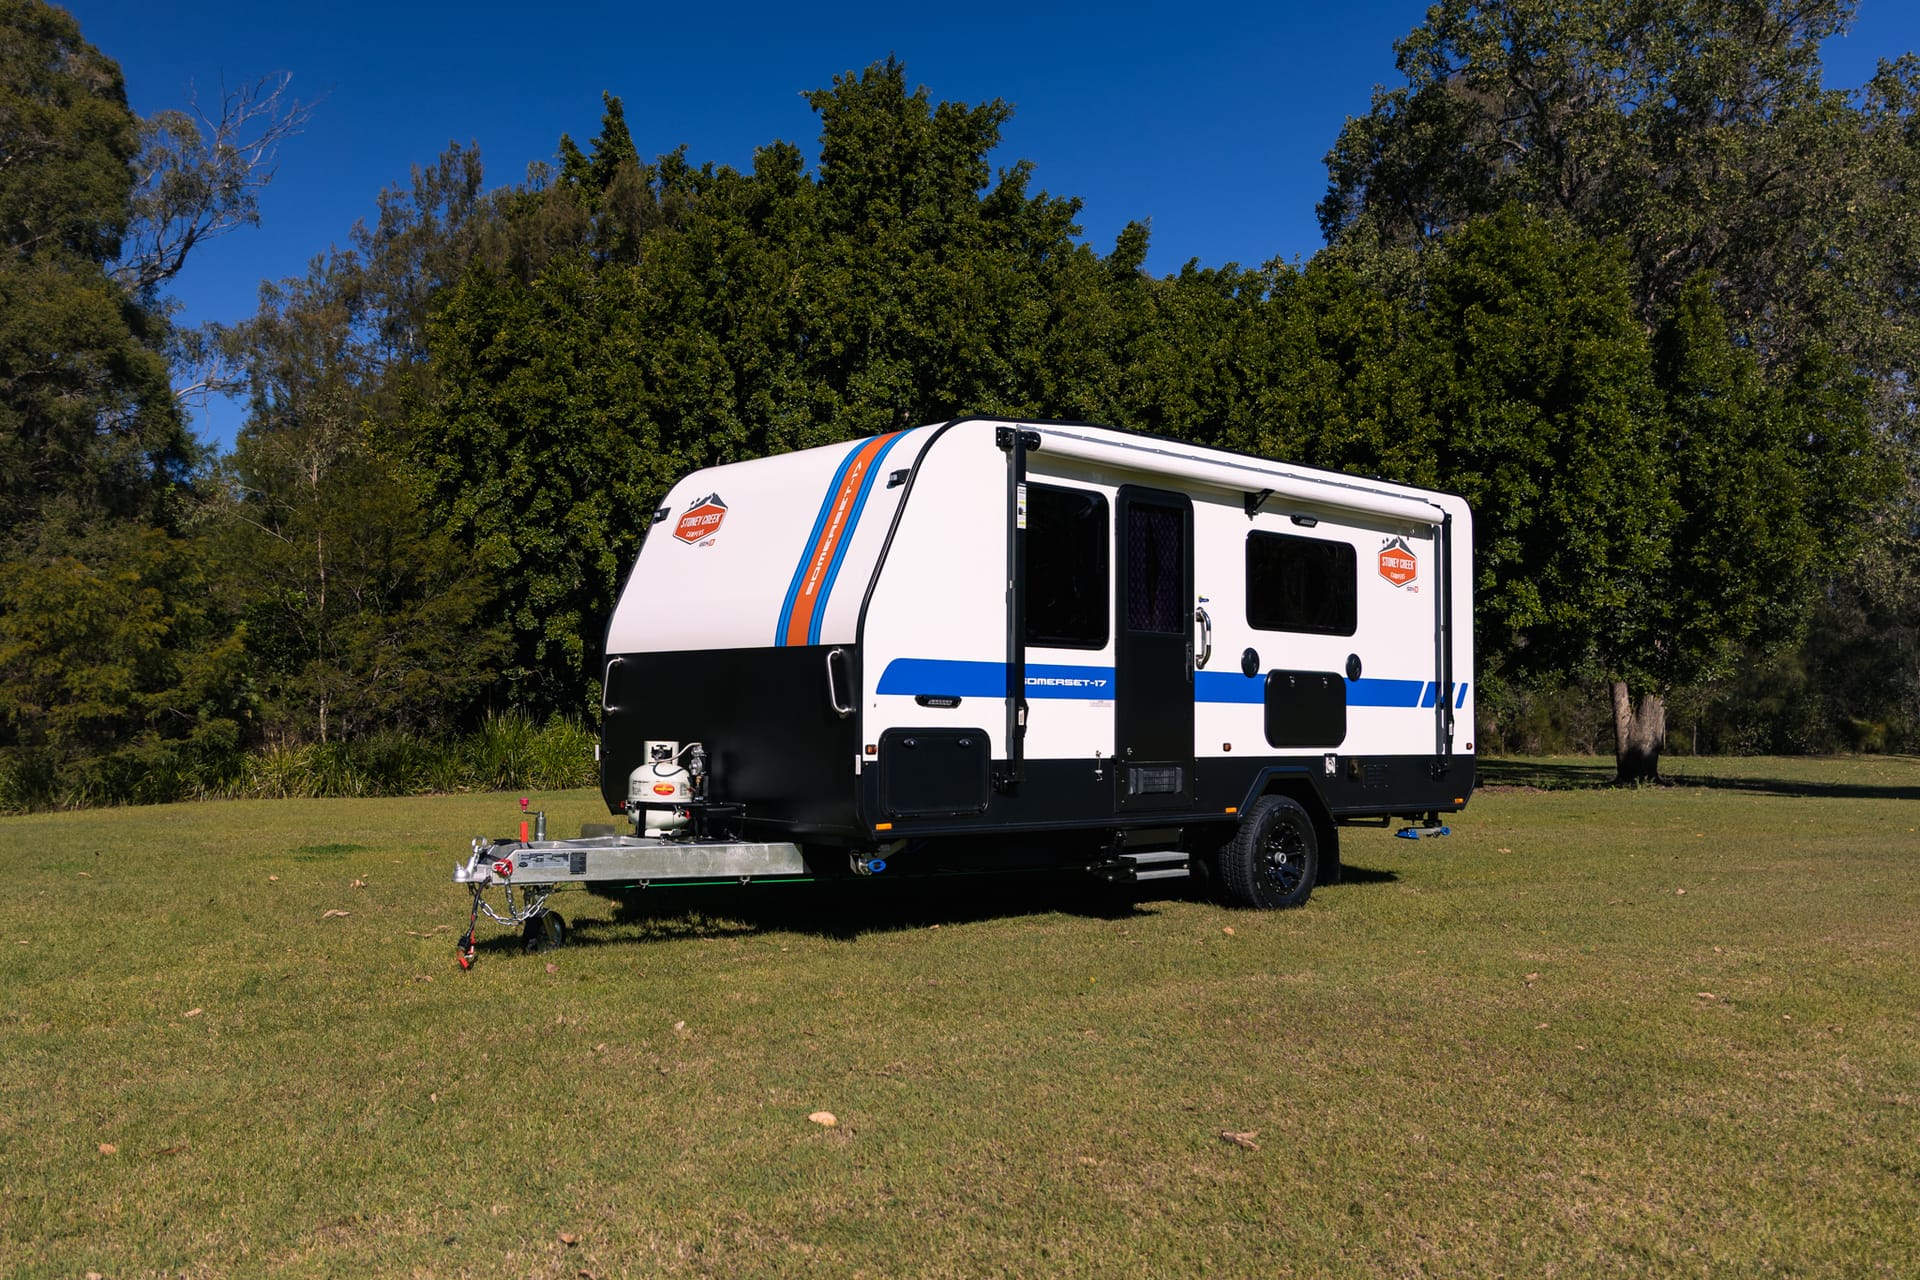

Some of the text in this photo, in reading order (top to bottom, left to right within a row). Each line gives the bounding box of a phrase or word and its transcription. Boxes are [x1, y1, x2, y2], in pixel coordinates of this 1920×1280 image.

[681, 513, 722, 528] STONEY CREEK
[805, 461, 863, 596] SOMERSET-17
[1382, 556, 1415, 570] STONEY CREEK
